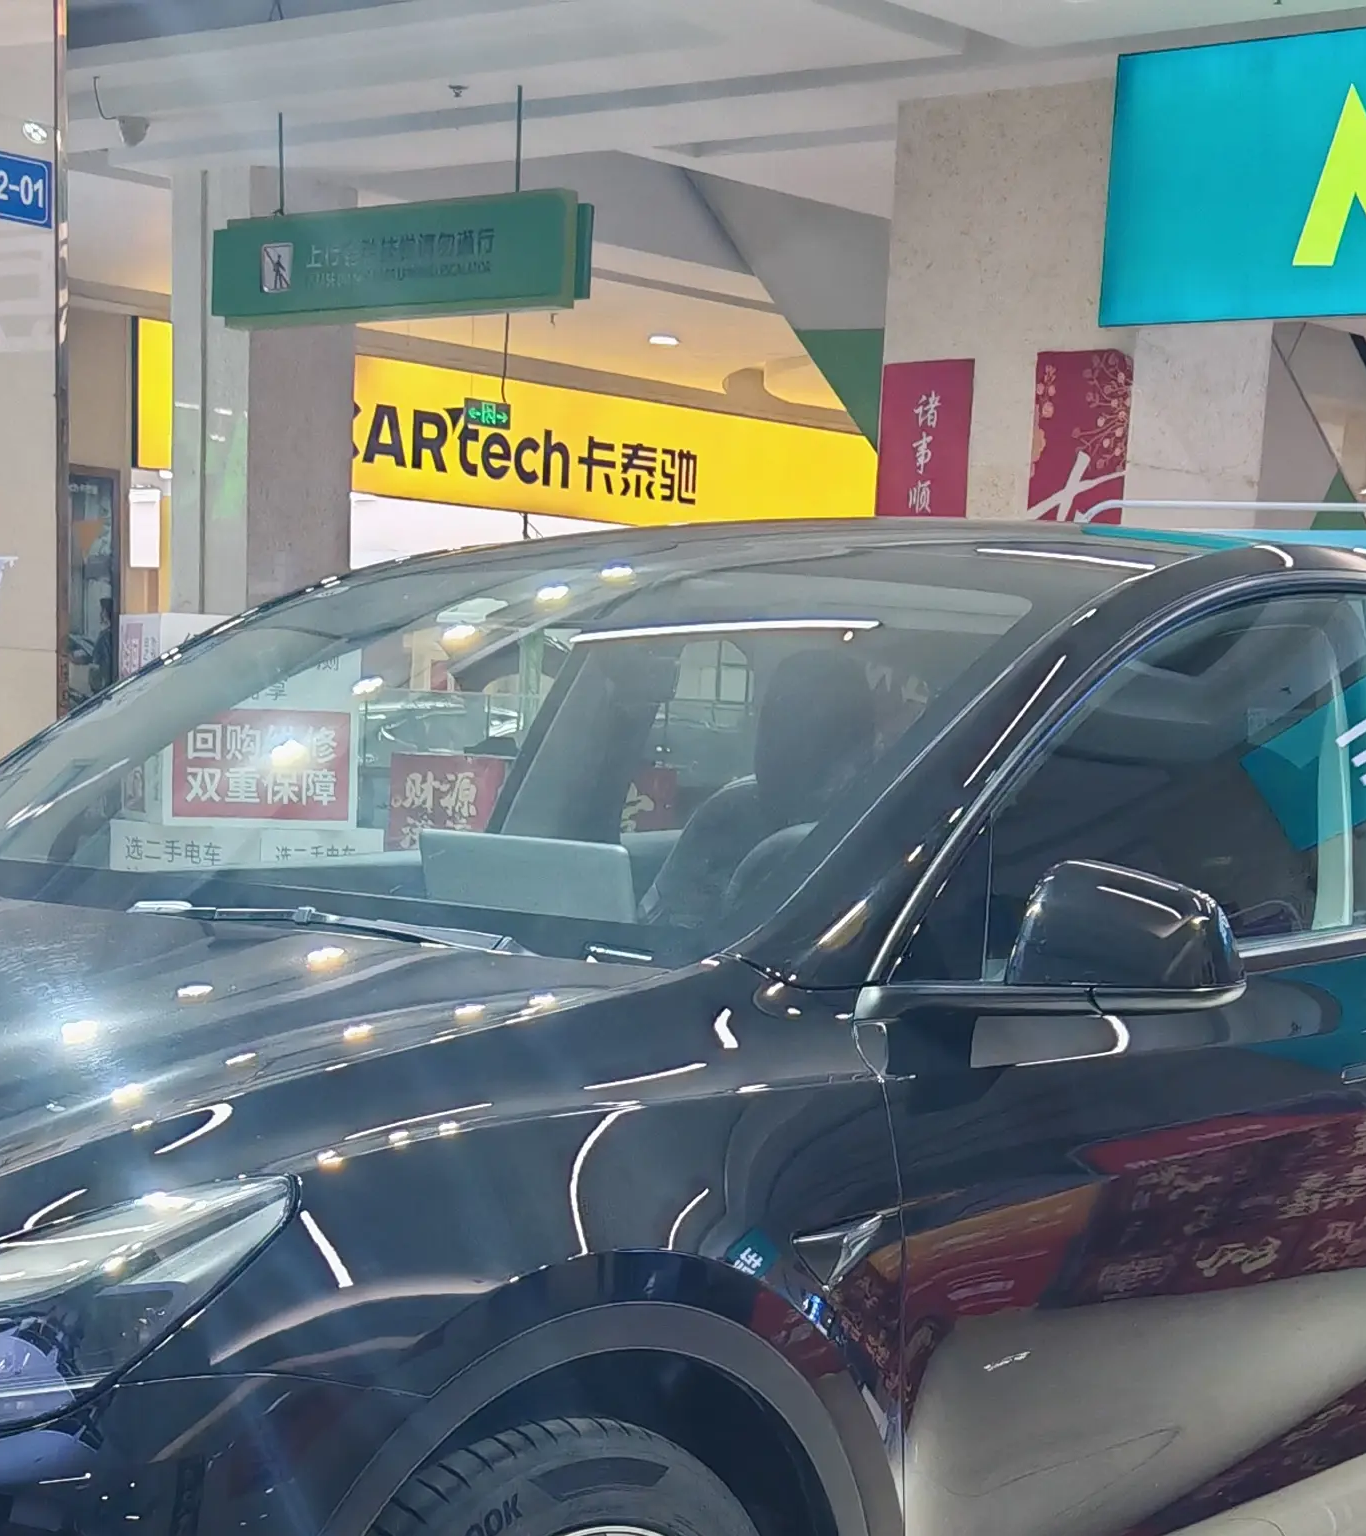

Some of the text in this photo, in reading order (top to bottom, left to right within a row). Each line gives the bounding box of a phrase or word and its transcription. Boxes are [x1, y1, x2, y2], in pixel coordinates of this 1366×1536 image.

[352, 399, 698, 506] ARtech 卡泰驰
[908, 390, 942, 514] 诸事顺
[186, 766, 337, 806] 双重保障
[125, 836, 223, 866] 选二手电车
